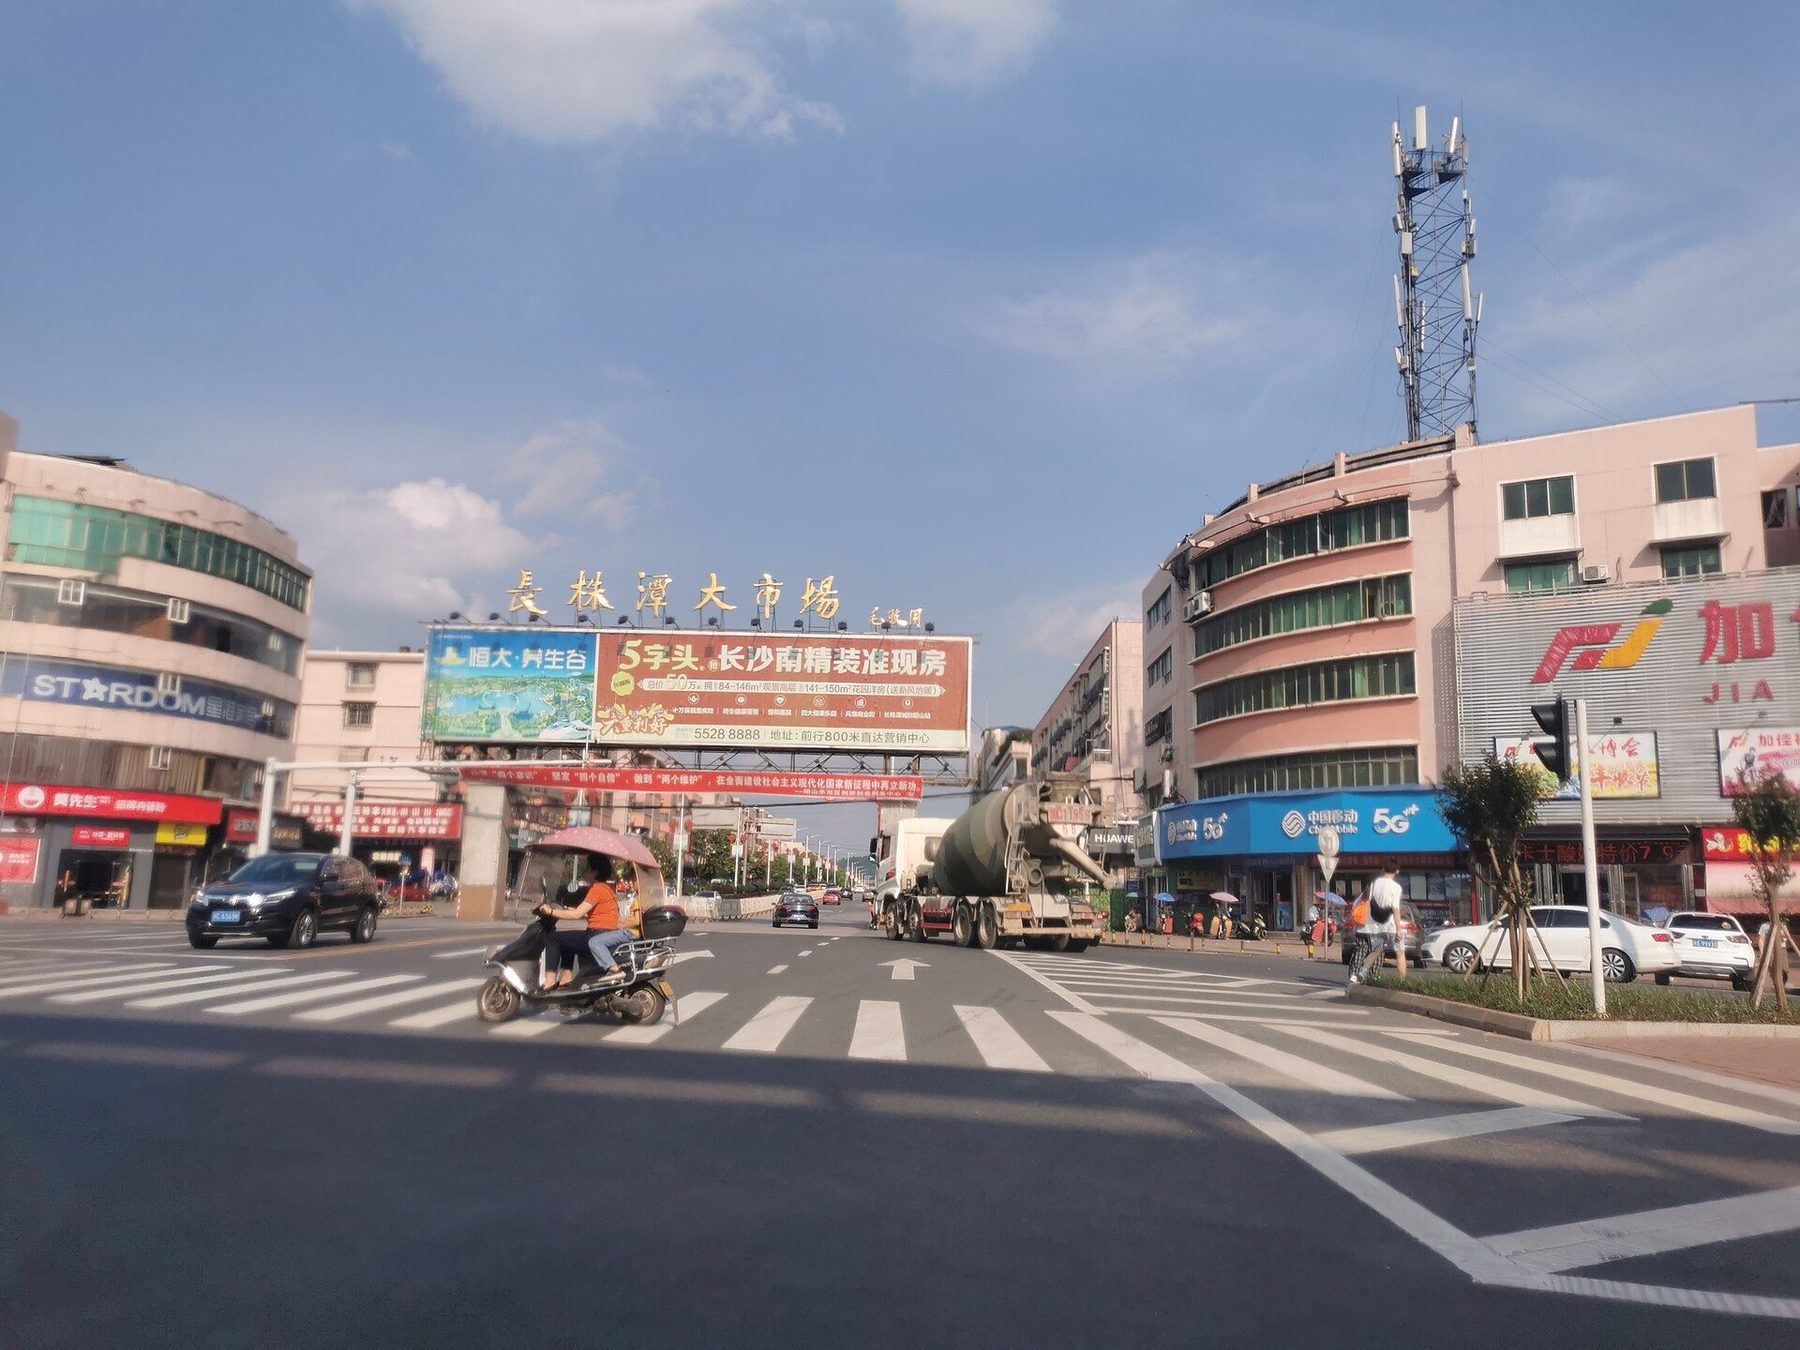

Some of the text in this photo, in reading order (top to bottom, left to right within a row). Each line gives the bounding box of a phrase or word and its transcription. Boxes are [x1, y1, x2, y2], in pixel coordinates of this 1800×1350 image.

[619, 639, 699, 671] 5字头
[718, 643, 947, 676] 长沙南精装准现房
[1703, 678, 1774, 703] JIA
[694, 729, 725, 740] 5528
[728, 729, 760, 740] 8888
[1307, 809, 1358, 825] 中国移动
